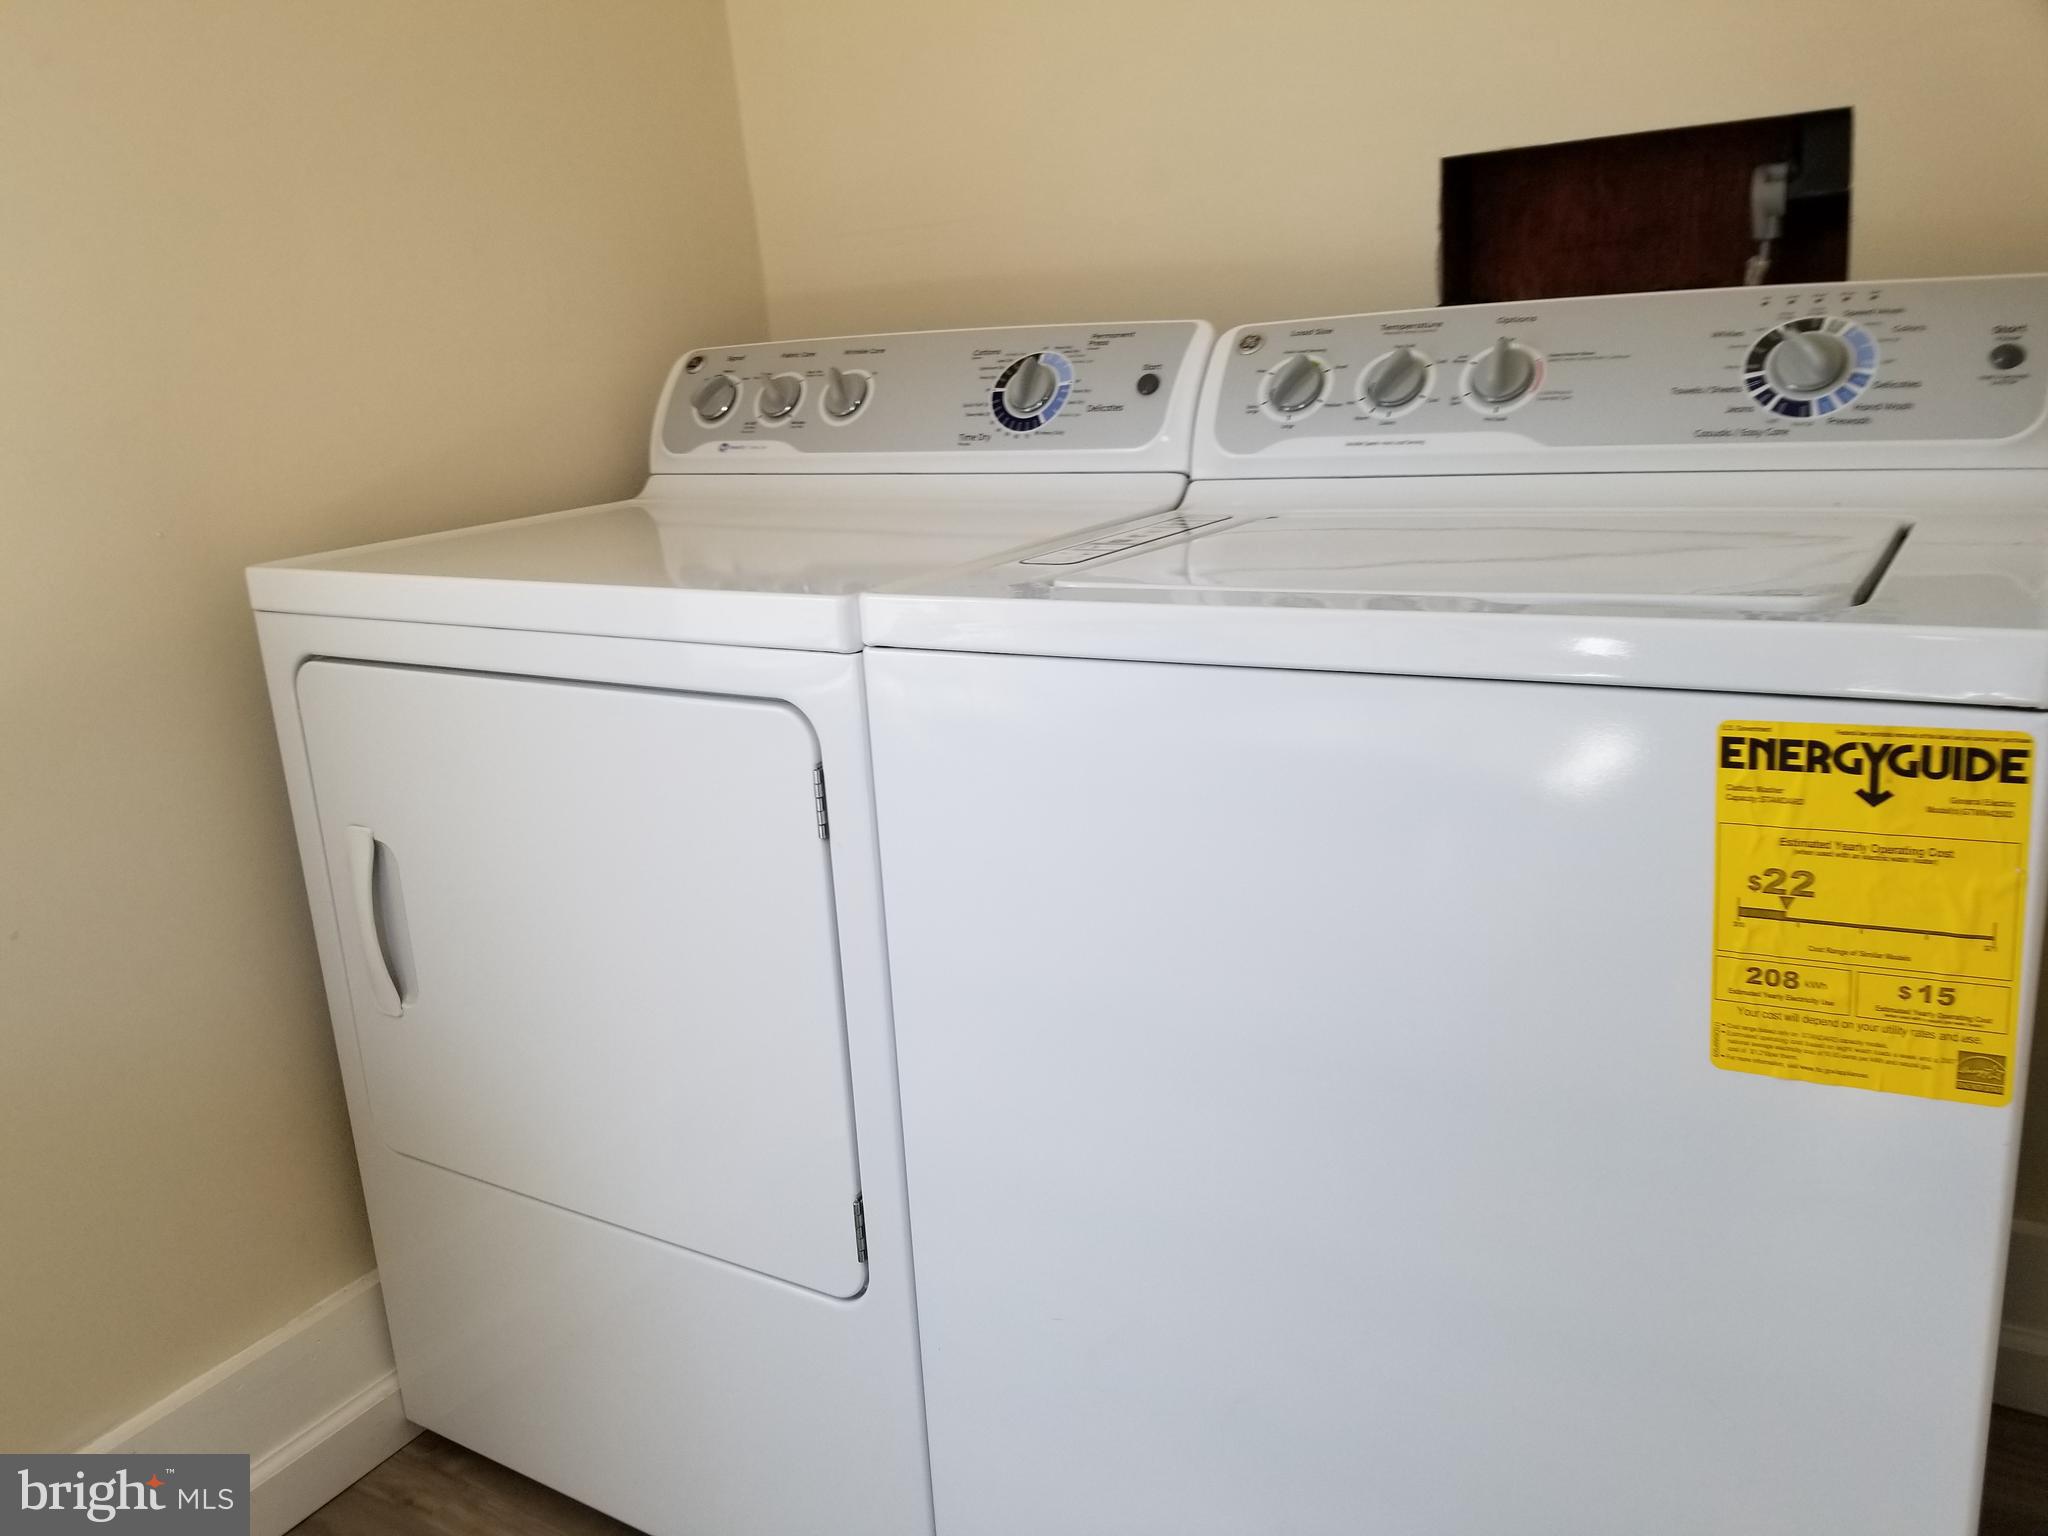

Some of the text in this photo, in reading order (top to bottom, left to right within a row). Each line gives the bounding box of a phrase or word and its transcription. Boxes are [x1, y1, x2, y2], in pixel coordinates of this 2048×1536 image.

[1721, 736, 2030, 795] ENERGYGUIDE
[1779, 837, 1955, 858] Estimated Yearly Operating Cost
[1748, 867, 1816, 898] $22
[1745, 966, 1800, 990] 208
[1736, 1006, 1760, 1018] Your
[1762, 1010, 1782, 1021] cost
[1802, 1015, 1840, 1028] depend
[1841, 1020, 1855, 1029] on
[1856, 1023, 1879, 1033] your
[1940, 1032, 1959, 1042] and
